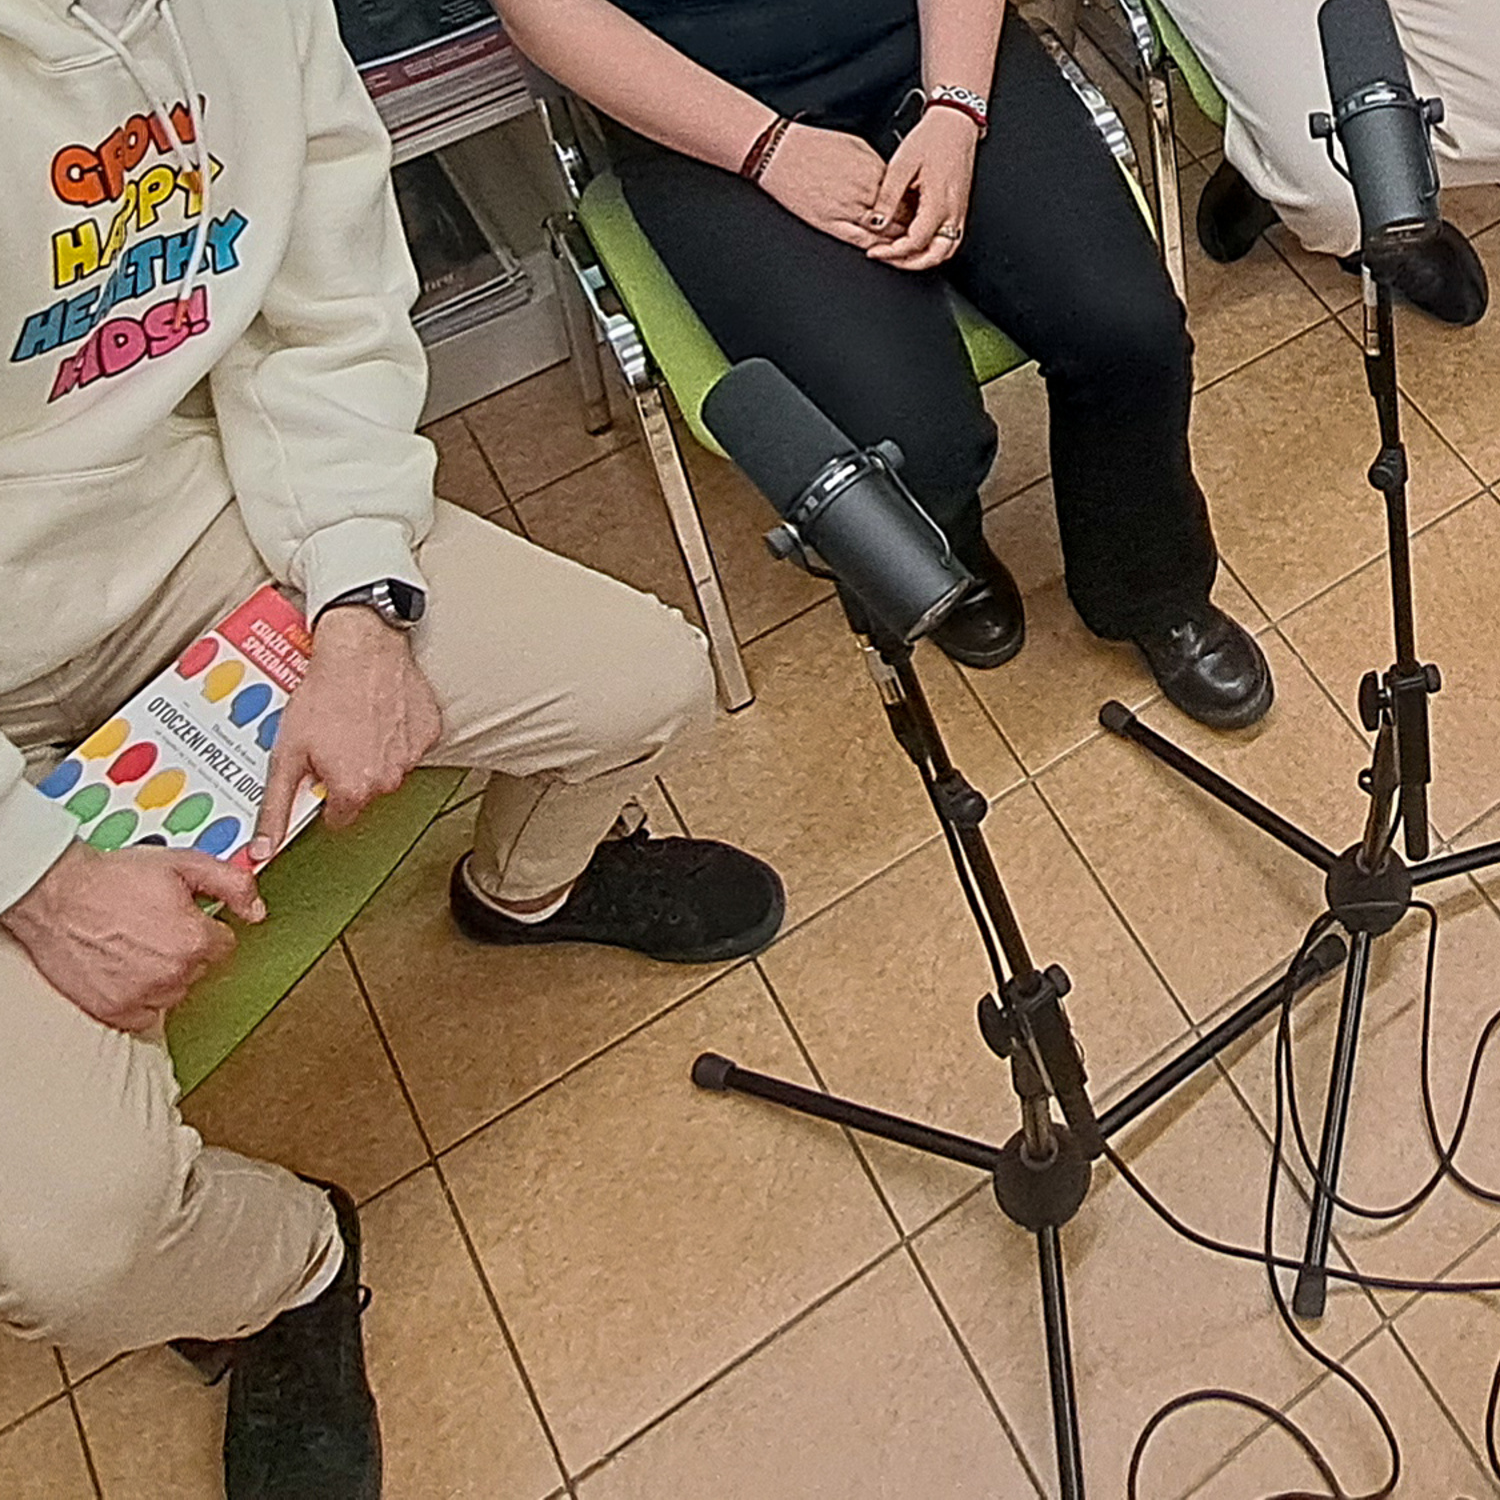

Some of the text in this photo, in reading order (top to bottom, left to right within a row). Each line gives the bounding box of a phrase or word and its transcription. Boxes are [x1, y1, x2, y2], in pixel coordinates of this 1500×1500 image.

[52, 153, 224, 290] HAPPY
[10, 208, 249, 363] HEALTHY
[239, 634, 302, 690] SPRZEDANYC
[146, 693, 208, 753] OTOCZENI
[197, 740, 243, 784] PRZEZ
